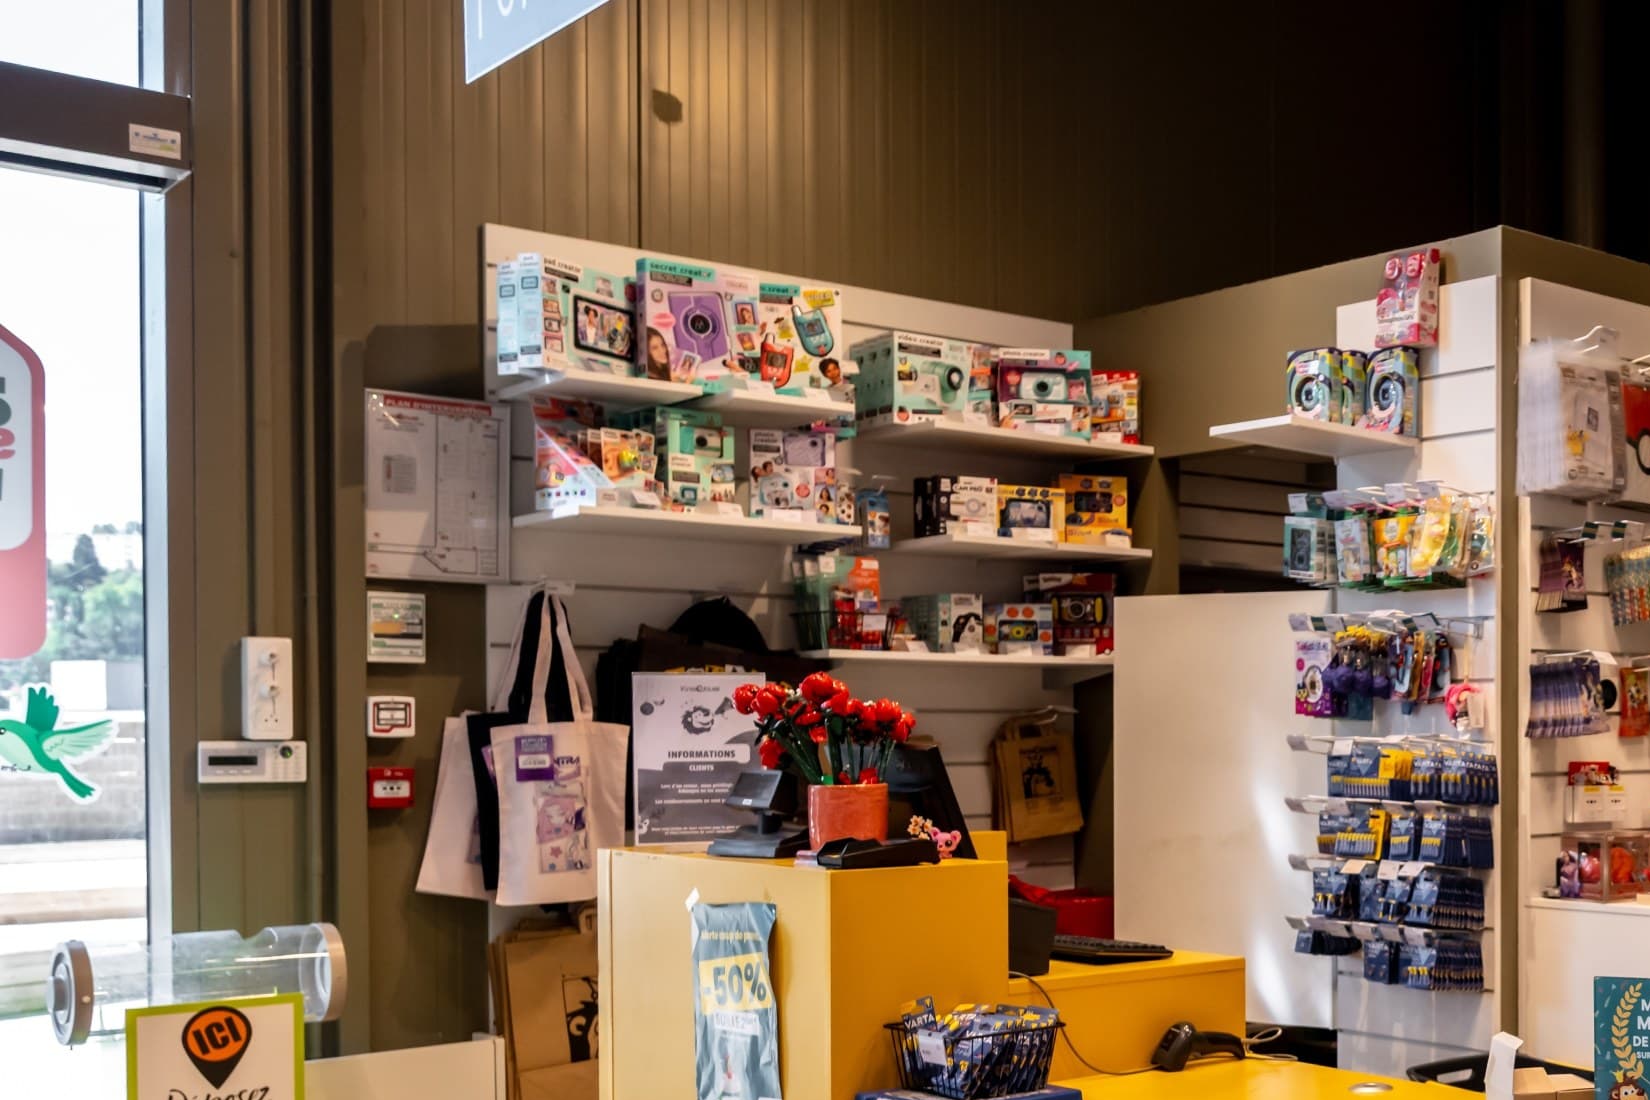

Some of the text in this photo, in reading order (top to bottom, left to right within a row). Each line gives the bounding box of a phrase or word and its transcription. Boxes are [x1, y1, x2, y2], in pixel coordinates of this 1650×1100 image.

[668, 749, 736, 759] INFORMATIONS
[703, 961, 767, 1006] -50%
[904, 1014, 935, 1029] VARTA
[192, 1016, 242, 1055] ICI
[1632, 1036, 1649, 1047] DE
